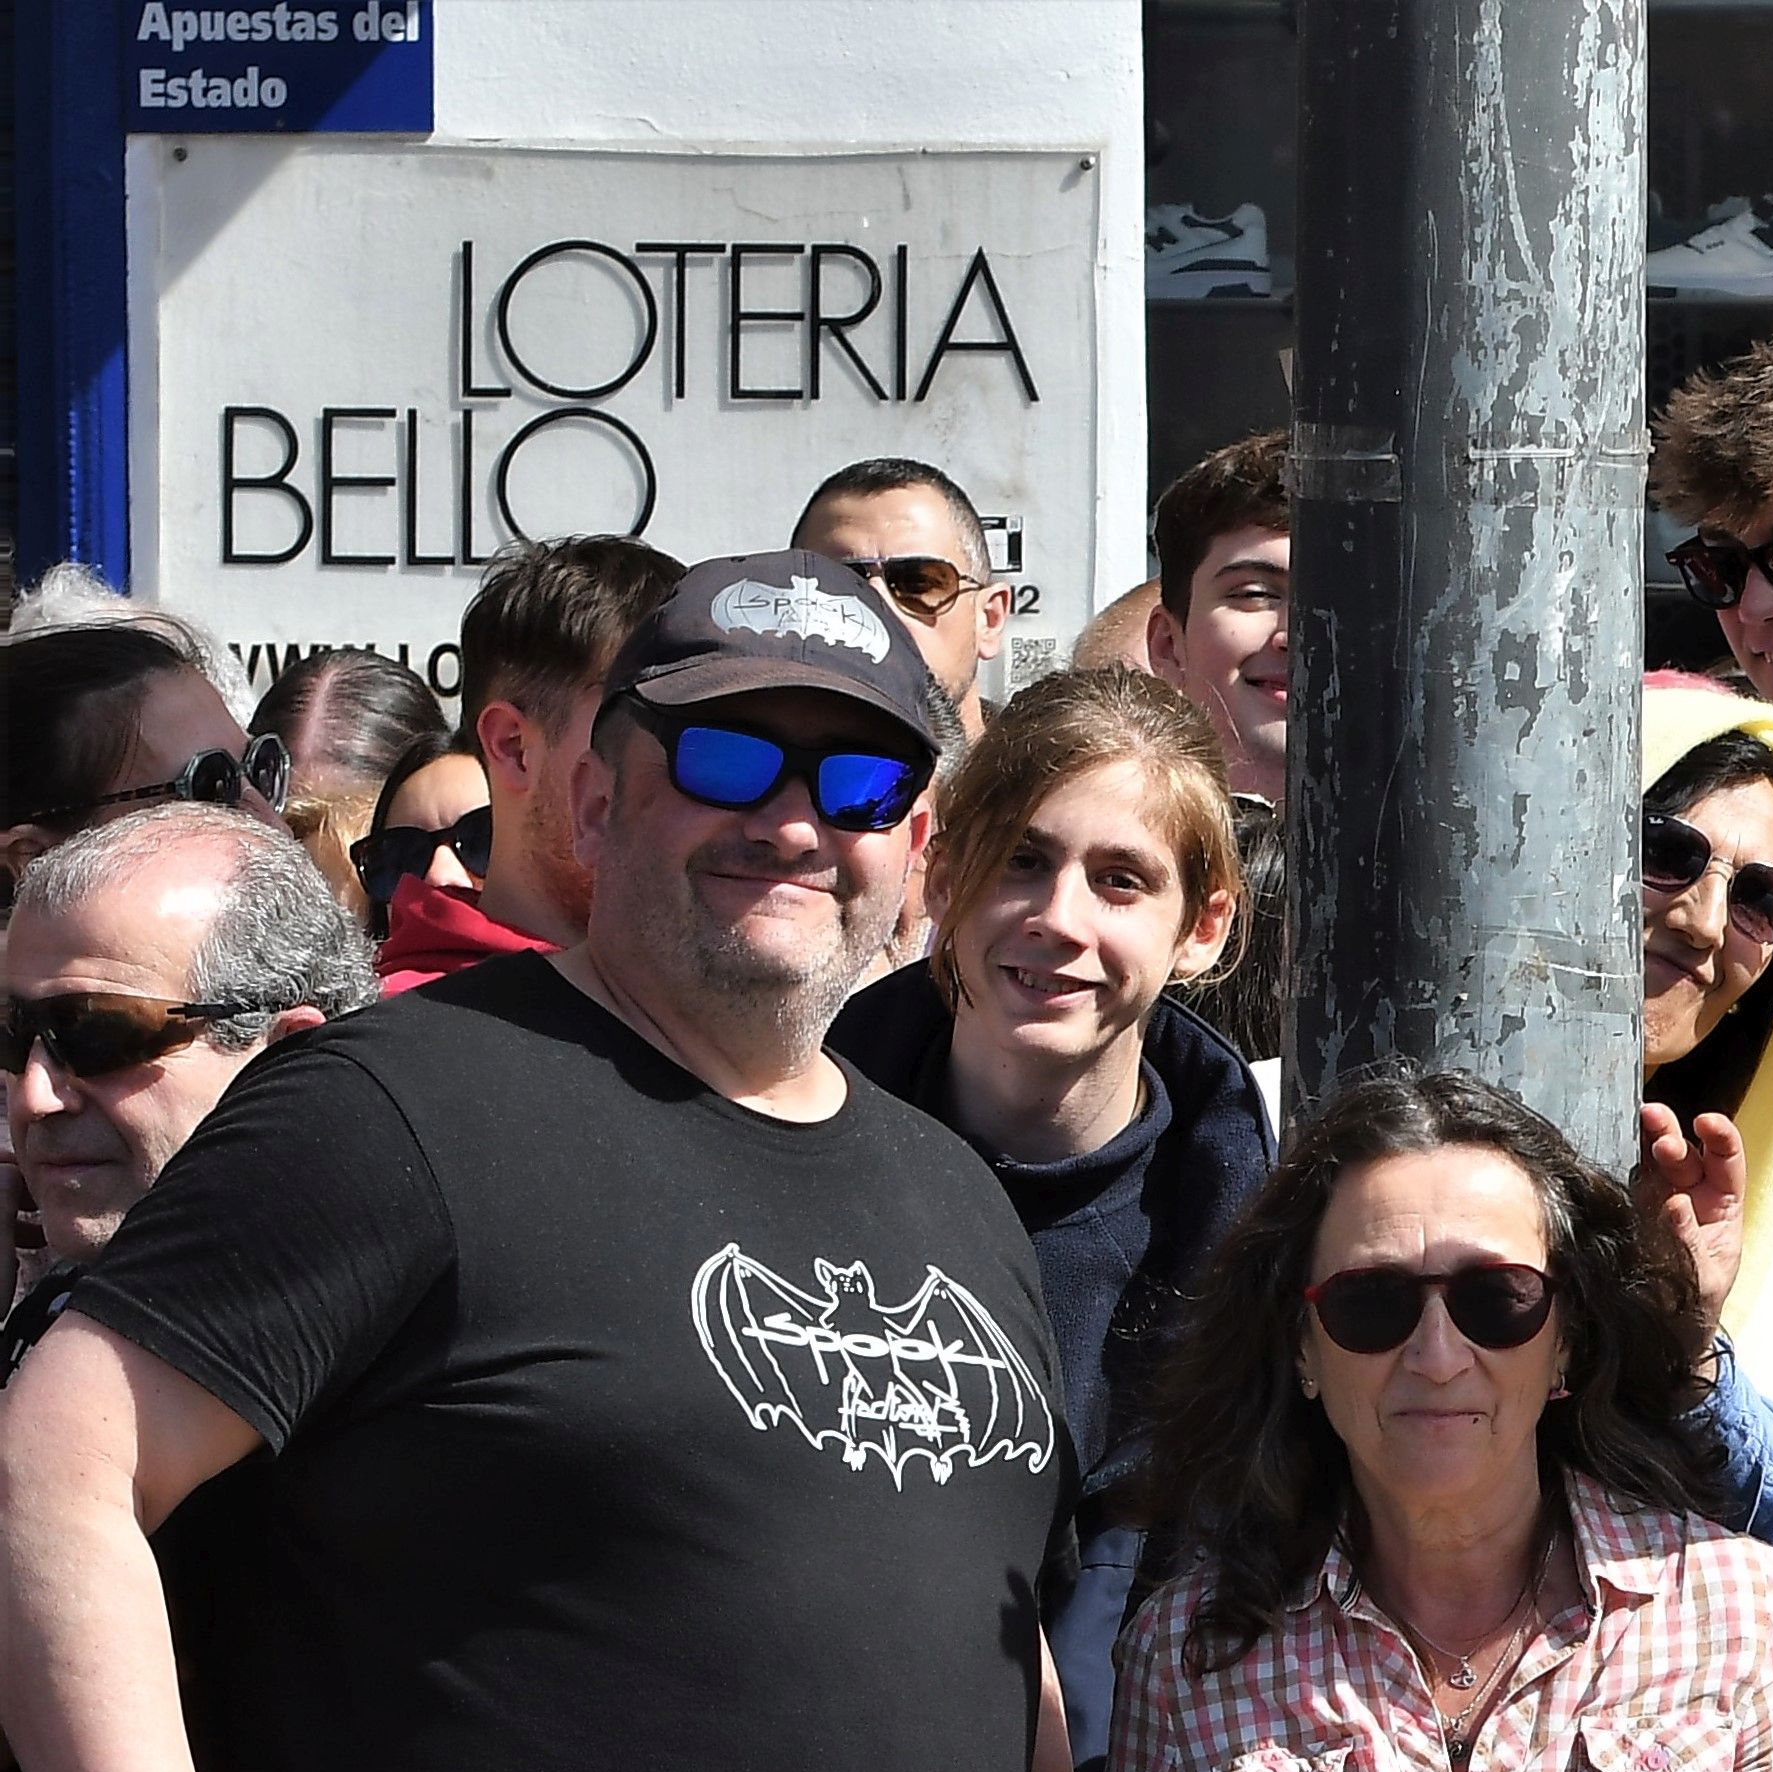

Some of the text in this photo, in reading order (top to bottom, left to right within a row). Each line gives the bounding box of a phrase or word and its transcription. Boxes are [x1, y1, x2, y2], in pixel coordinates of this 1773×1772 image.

[137, 0, 420, 51] Apuestas del
[139, 66, 288, 108] Estado
[460, 240, 1040, 402] LOTERIA
[222, 407, 658, 566] BELLO
